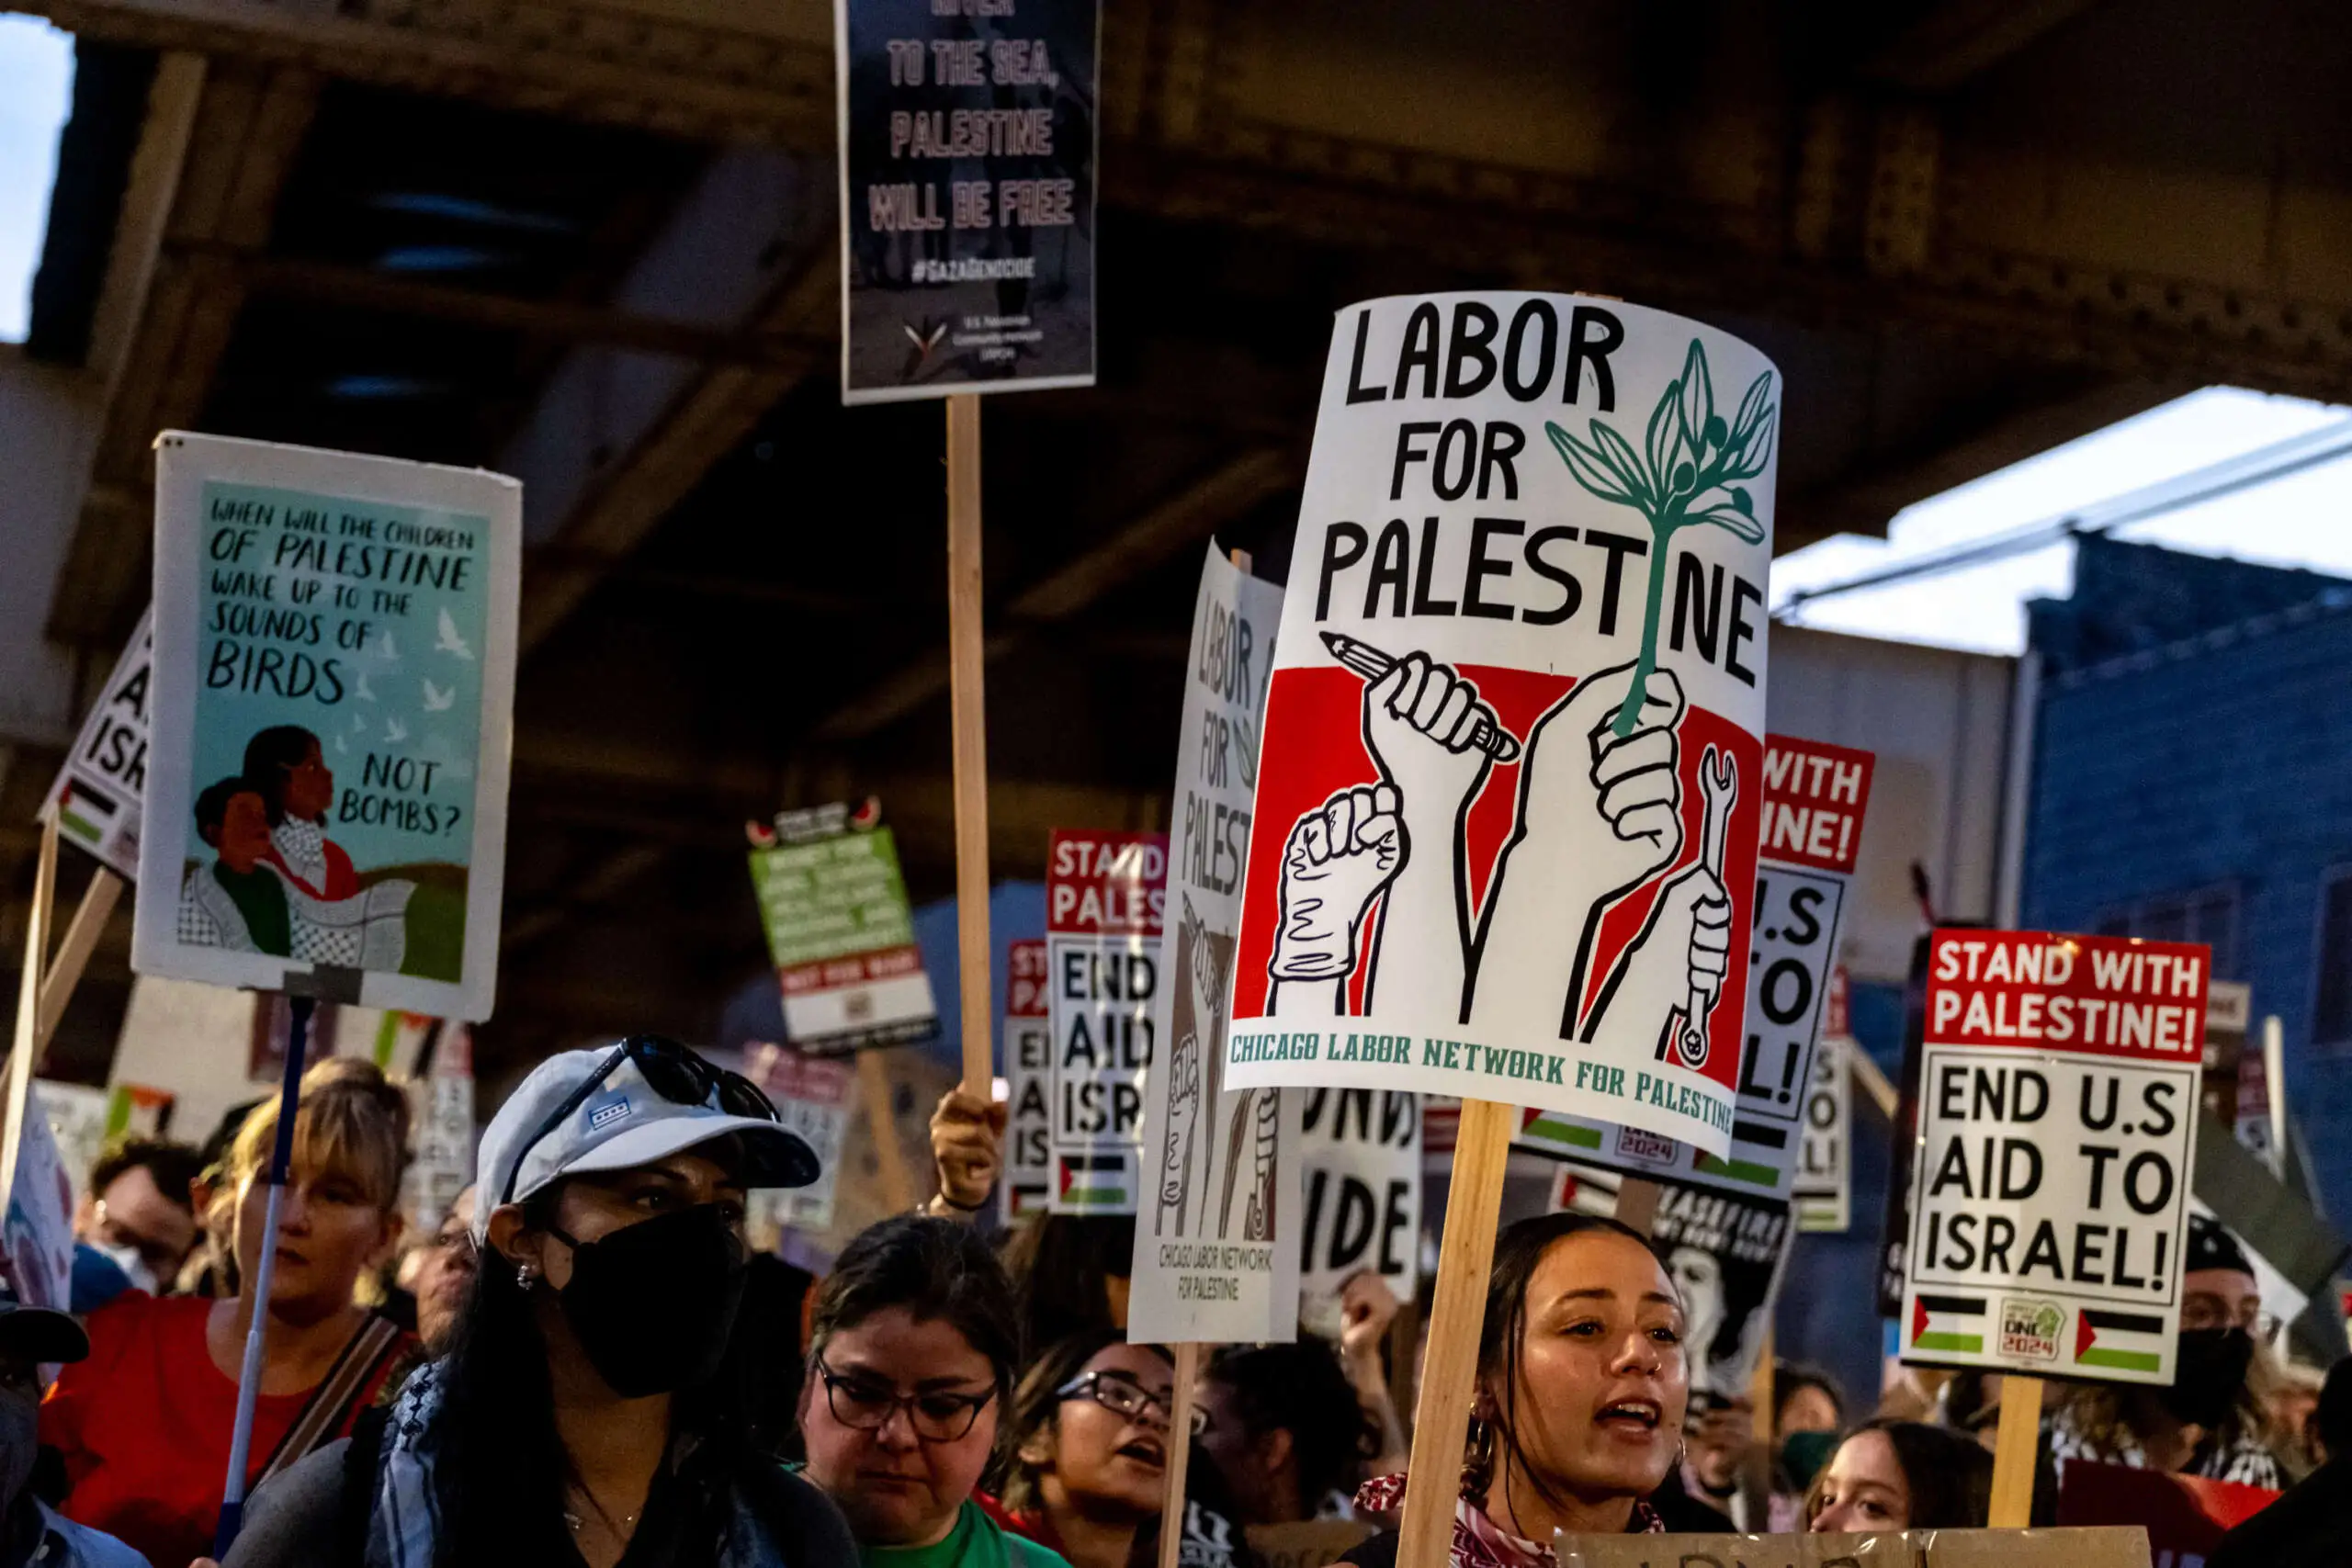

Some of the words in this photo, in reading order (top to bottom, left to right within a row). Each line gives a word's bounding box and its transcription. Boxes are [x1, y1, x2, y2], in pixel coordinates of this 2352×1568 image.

[887, 39, 924, 86] TO
[931, 39, 986, 86] THE
[991, 39, 1059, 89] SEA,
[890, 108, 1055, 159] PALESTINE
[868, 182, 945, 231] WILL
[953, 181, 992, 229] BE
[999, 178, 1075, 228] FREE
[1346, 299, 1624, 413] LABOR
[1389, 418, 1525, 502] FOR
[211, 499, 273, 527] WHEN
[284, 508, 330, 535] WILL
[338, 514, 377, 540] THE
[384, 521, 475, 550] CHILDREN
[210, 527, 259, 563] OF
[275, 534, 472, 592] PALESTINE
[210, 569, 277, 602] WAKE
[291, 578, 322, 604] UP
[334, 583, 359, 610] TO
[372, 590, 413, 616] THE
[209, 601, 323, 646] SOUNDS
[337, 620, 374, 651] OF
[1198, 591, 1253, 711] LABOR
[207, 638, 345, 705] BIRDS
[363, 752, 441, 796] NOT
[1200, 709, 1229, 790] FOR
[1763, 748, 1862, 806] WITH
[339, 787, 461, 838] BOMBS?
[1063, 951, 1157, 1001] END
[1935, 942, 2073, 986] STAND
[2092, 949, 2200, 998] WITH
[1063, 1013, 1155, 1068] AID
[1934, 990, 2197, 1053] PALESTINE!
[1230, 1033, 1319, 1064] CHICAGO
[1327, 1033, 1412, 1065] LABOR
[1422, 1038, 1566, 1085] NETWORK
[1576, 1060, 1625, 1098] FOR
[1634, 1071, 1732, 1136] PALESTINE
[1939, 1066, 2050, 1123] END
[2080, 1075, 2177, 1138] U.S
[1621, 1135, 1672, 1161] 2024
[1931, 1134, 2043, 1201] AID
[2079, 1145, 2174, 1215] TO
[1159, 1244, 1193, 1269] CHICAGO
[1194, 1246, 1218, 1269] LABOR
[1221, 1247, 1272, 1271] NETWORK
[1927, 1212, 2169, 1292] ISRAEL!
[1178, 1276, 1193, 1301] FOR
[1194, 1276, 1239, 1302] PALESTINE
[2002, 1337, 2053, 1356] 2024
